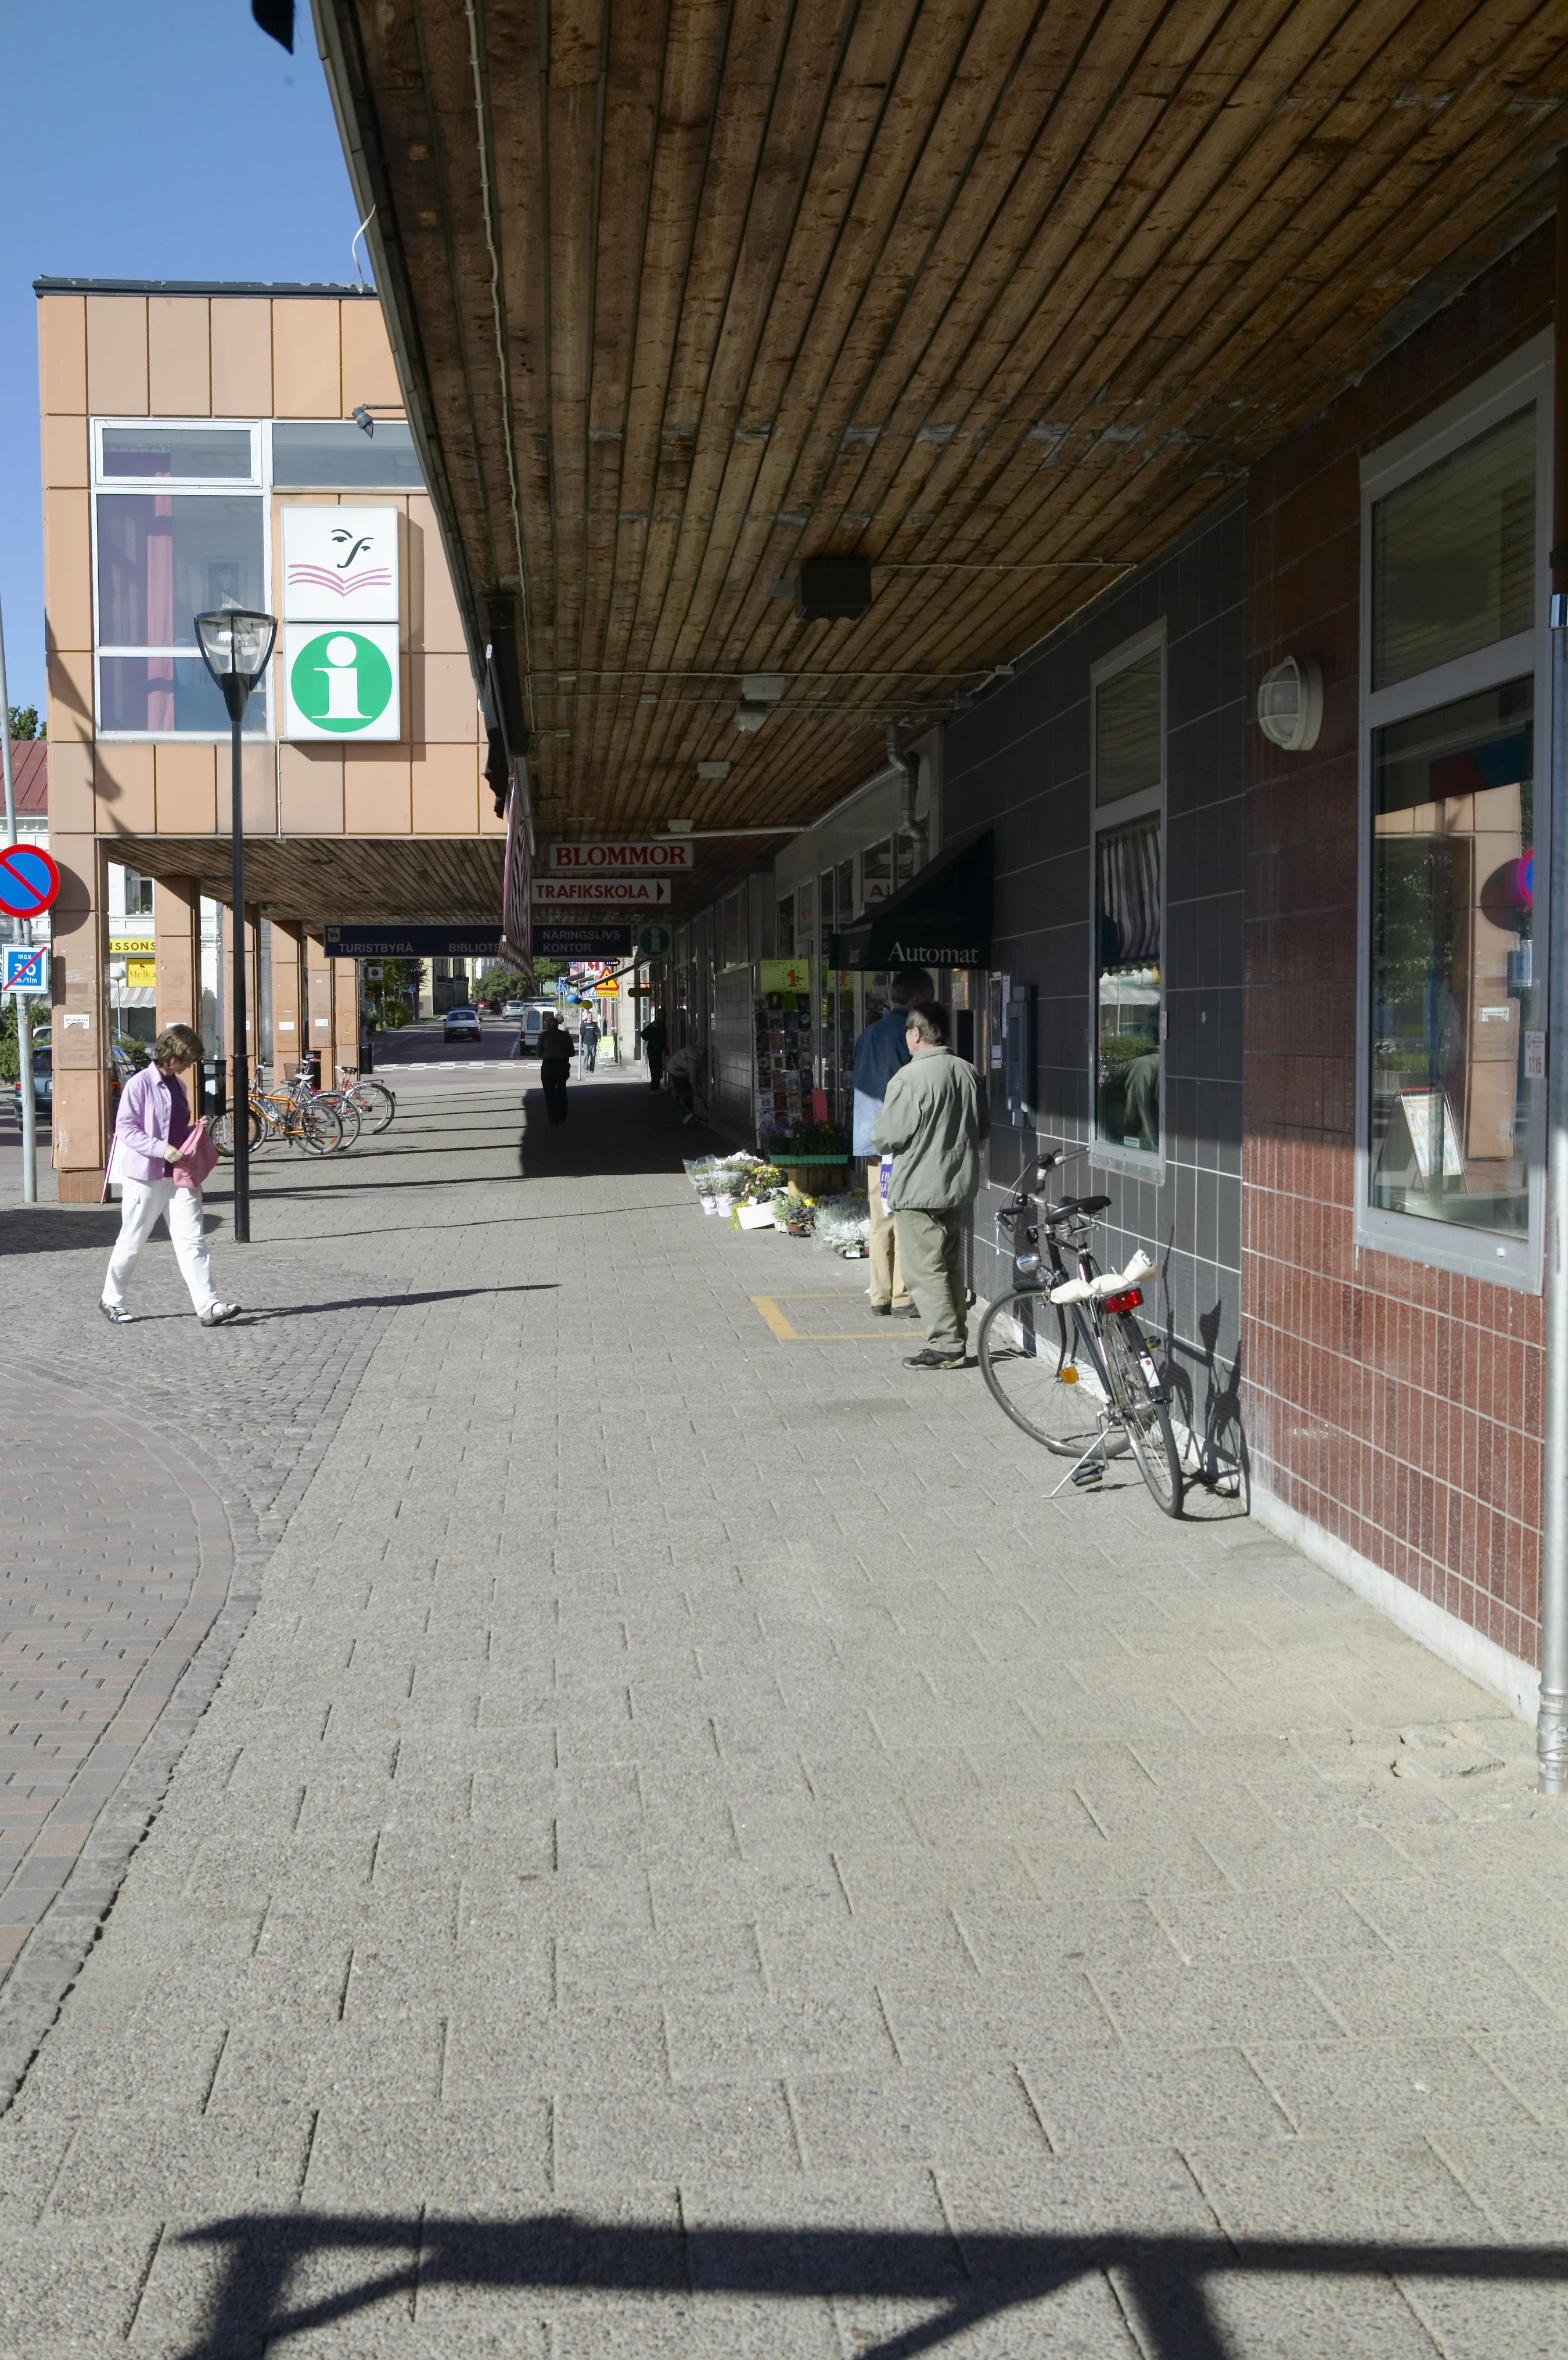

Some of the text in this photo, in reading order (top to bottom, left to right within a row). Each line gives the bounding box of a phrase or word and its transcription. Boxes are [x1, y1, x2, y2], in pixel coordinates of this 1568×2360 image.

[556, 846, 686, 866] BLOMMOR
[536, 884, 649, 898] TRAFIKSKOLA
[543, 929, 620, 940] NÄRINGSLIVS
[339, 941, 413, 953] TURISTBYRÅ
[448, 942, 500, 952] BIBLIOTE
[543, 943, 592, 952] KONTOR
[887, 941, 980, 964] Automat
[14, 963, 36, 976] 30
